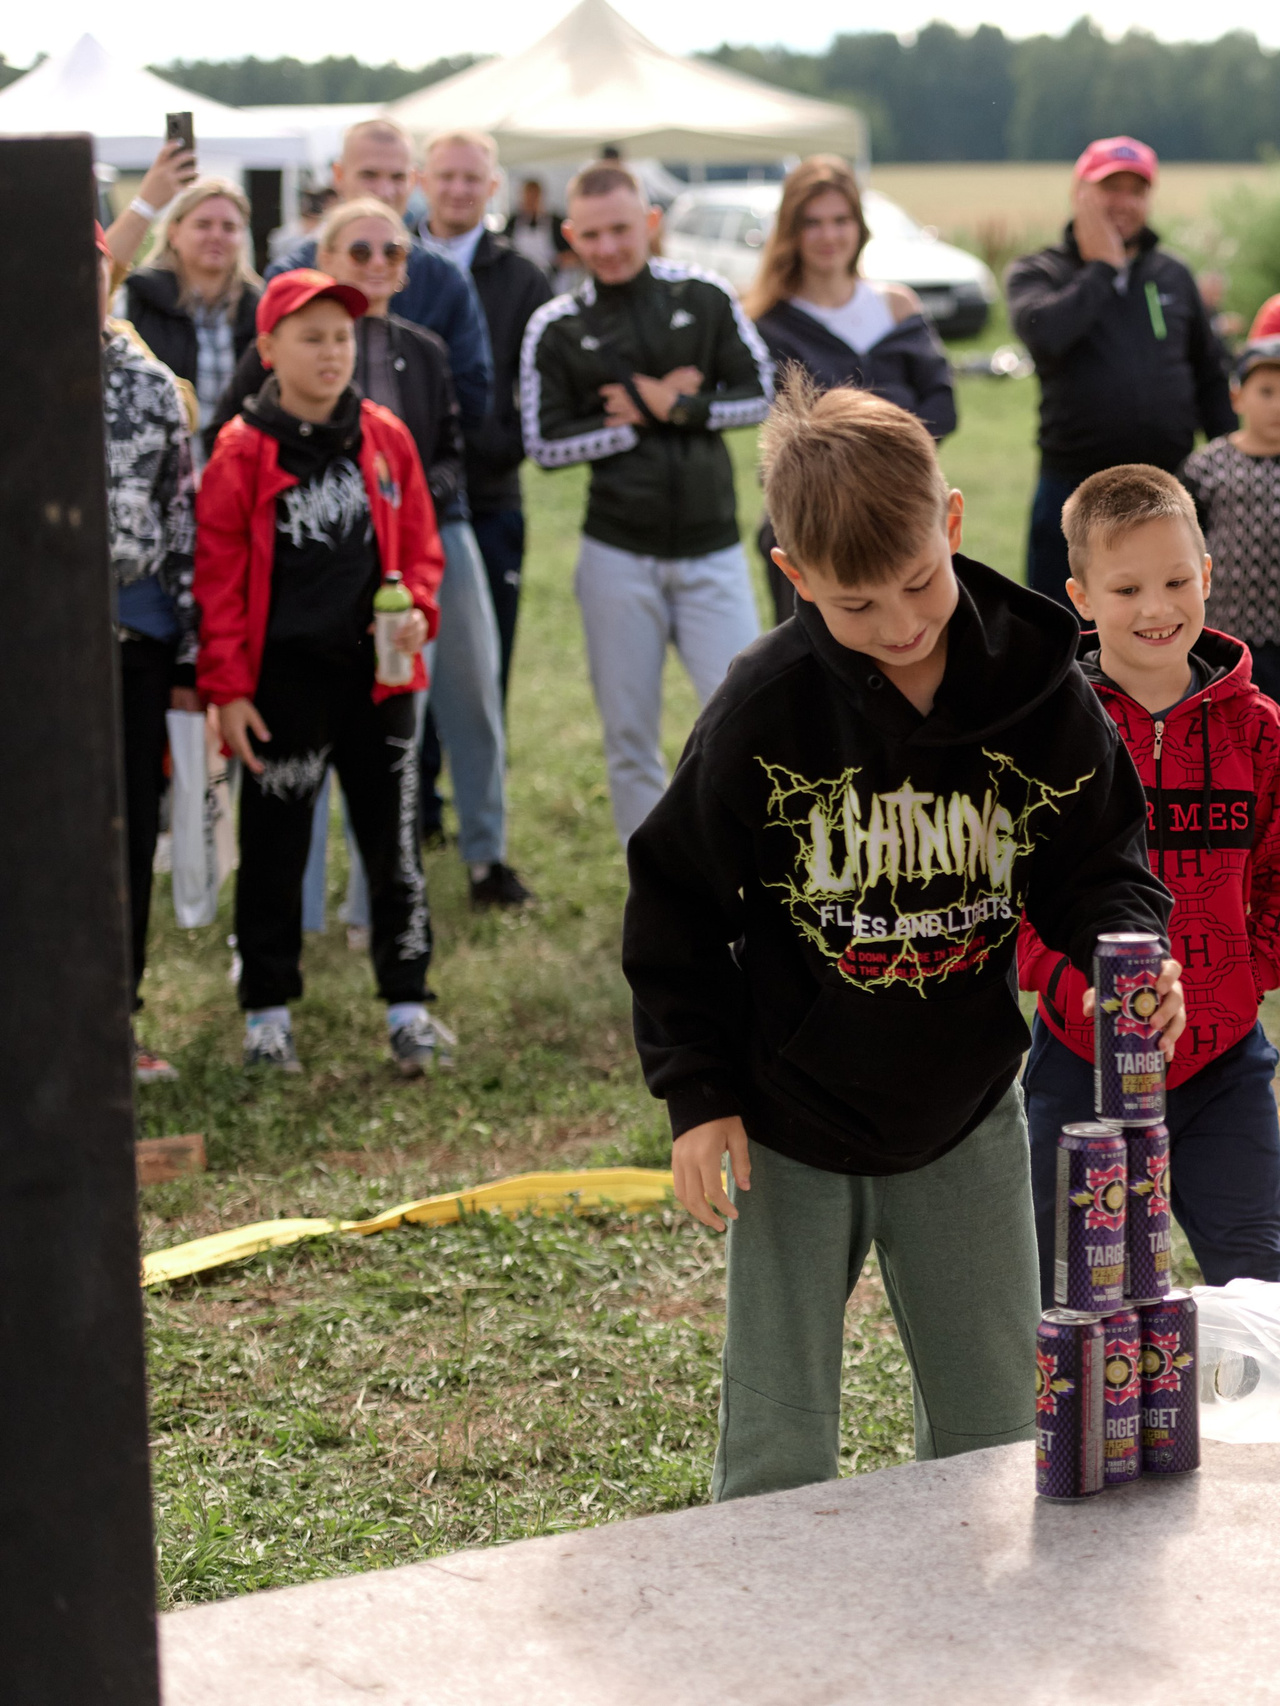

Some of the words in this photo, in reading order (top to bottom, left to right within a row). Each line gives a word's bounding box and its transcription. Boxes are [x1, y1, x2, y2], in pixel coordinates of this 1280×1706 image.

[895, 914, 942, 938] AND
[948, 896, 1012, 933] LIGHTS
[859, 965, 880, 977] THE
[1106, 1326, 1135, 1334] NERGY
[1107, 1415, 1141, 1439] RGET
